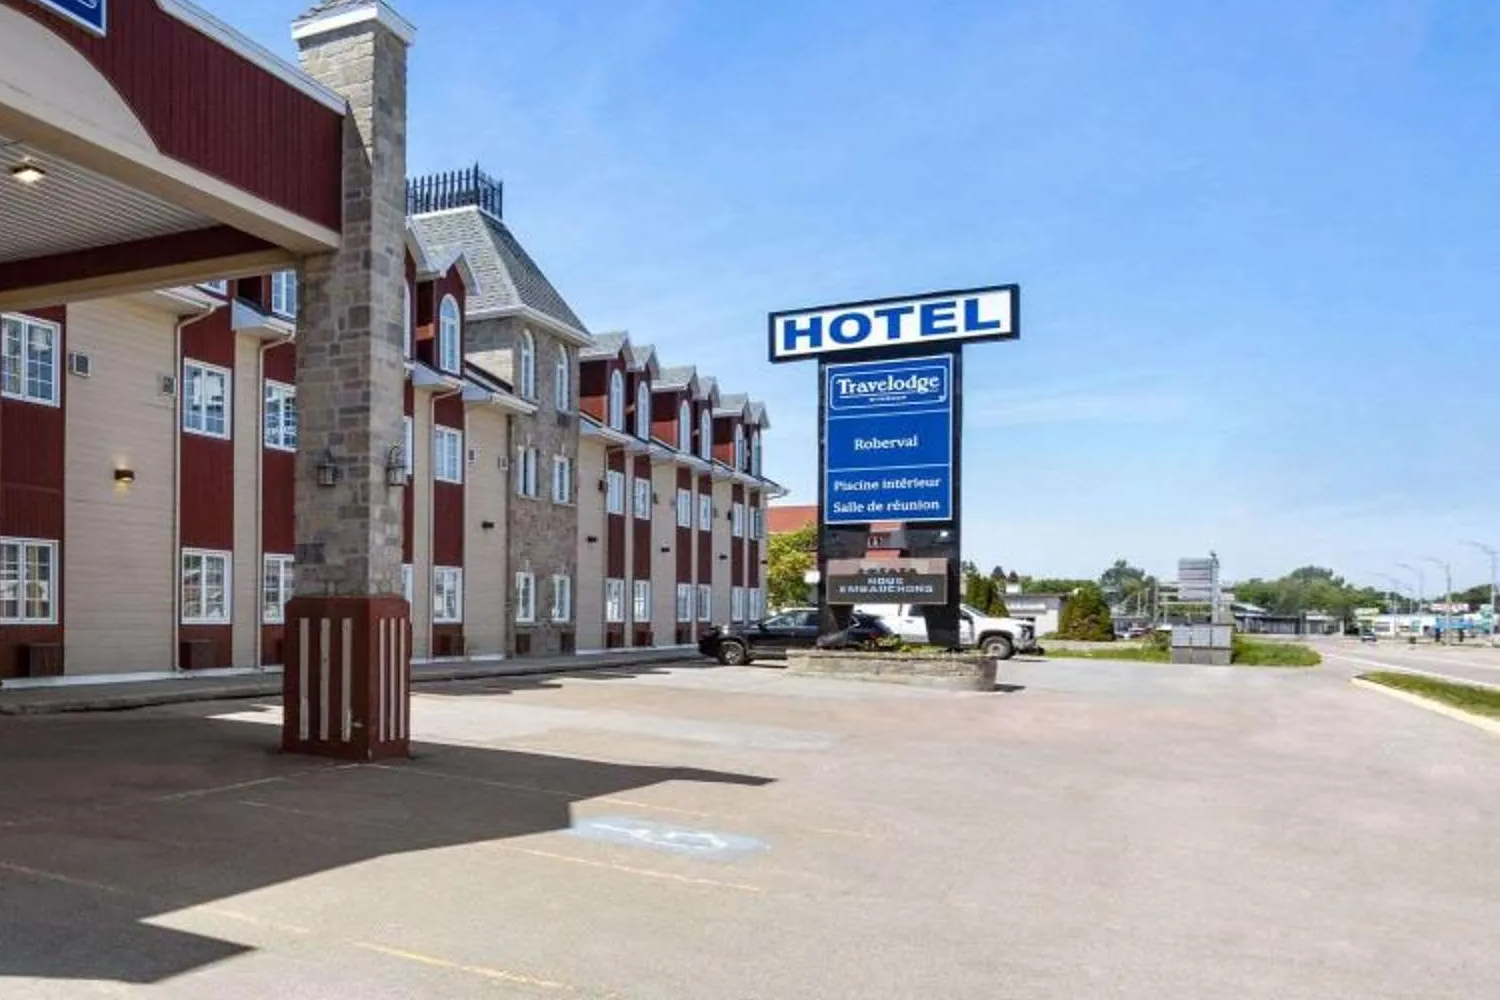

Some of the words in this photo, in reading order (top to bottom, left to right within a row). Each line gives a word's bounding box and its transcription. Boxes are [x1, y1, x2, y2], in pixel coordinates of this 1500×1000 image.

[783, 298, 1001, 350] HOTEL
[836, 375, 940, 394] Travelodge
[854, 434, 918, 450] Roberval
[833, 480, 879, 492] Piscine
[882, 477, 941, 489] intérieur
[833, 500, 864, 513] Salle
[867, 500, 884, 512] de
[887, 499, 940, 511] réunion
